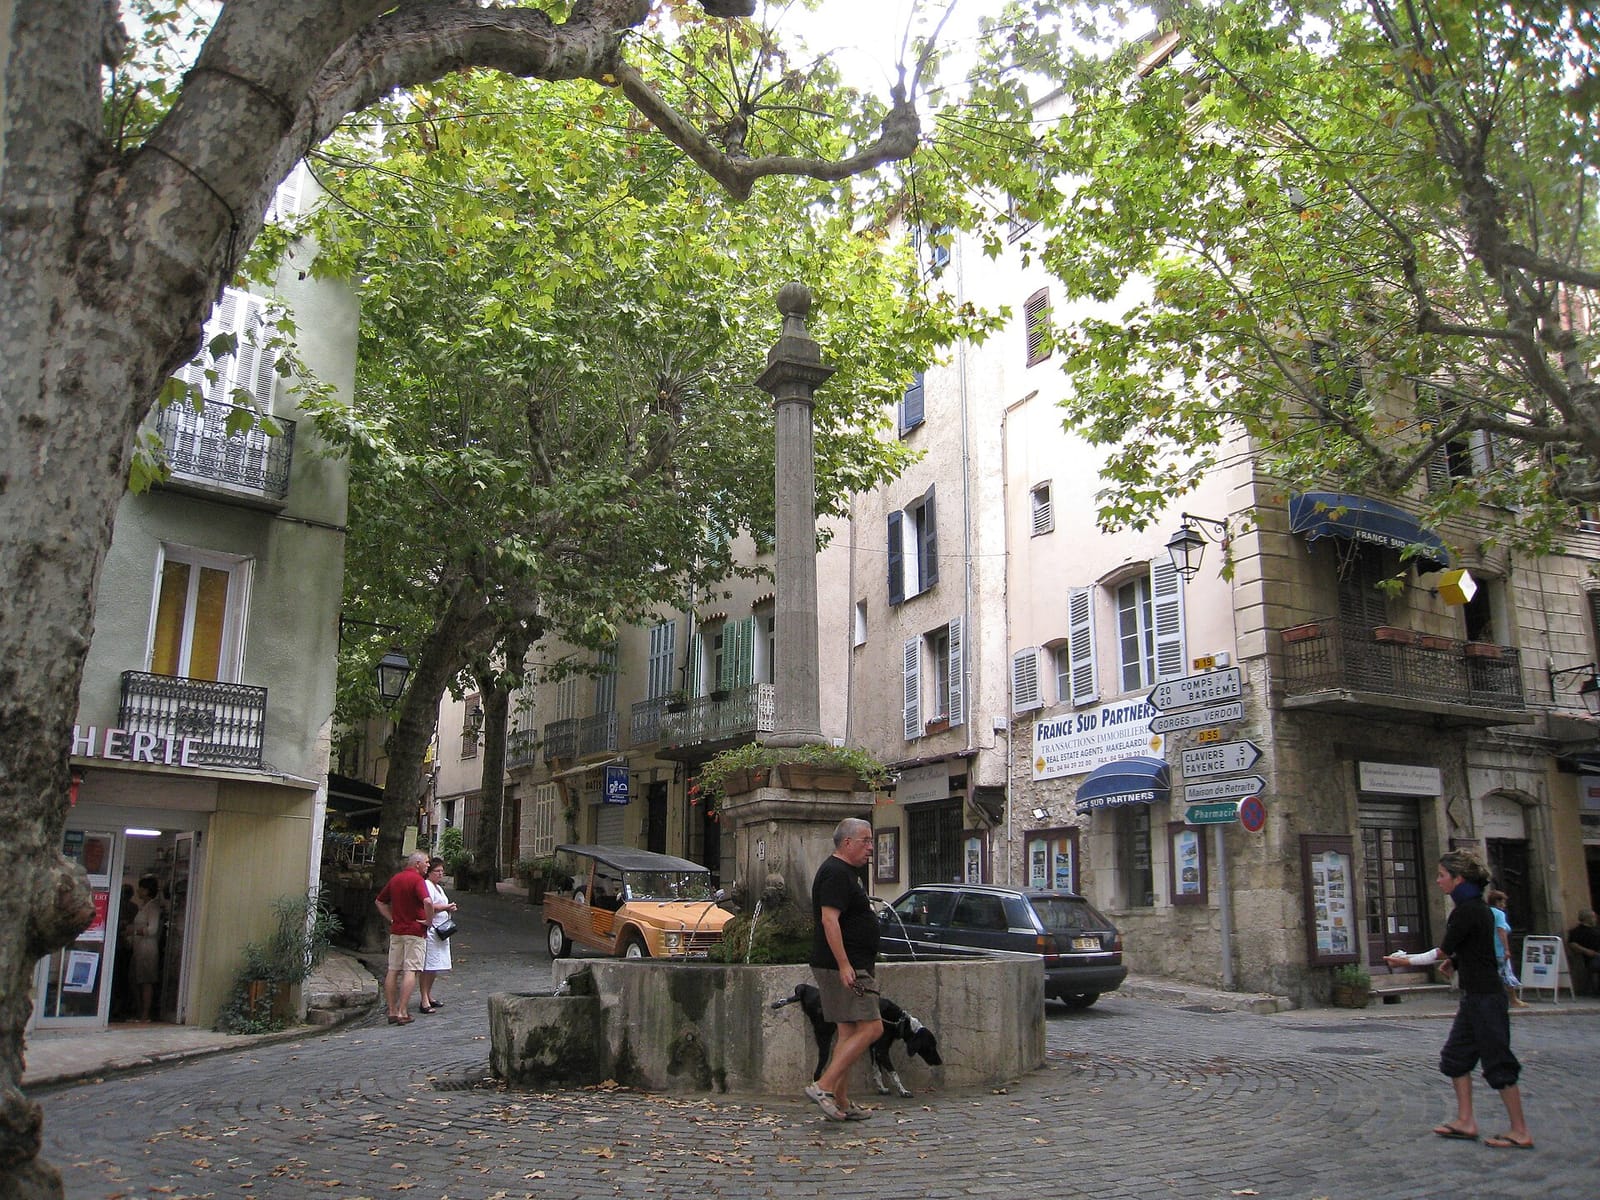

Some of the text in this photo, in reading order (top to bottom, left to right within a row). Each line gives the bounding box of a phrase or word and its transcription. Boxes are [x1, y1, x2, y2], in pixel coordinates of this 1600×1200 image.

[1356, 530, 1405, 548] FRANCE SUD
[1194, 658, 1212, 668] D 19
[1160, 686, 1171, 695] 20
[1181, 677, 1213, 691] COMPS
[1160, 697, 1172, 706] 20
[1037, 703, 1157, 741] FRANCE SUD PARTNERS
[1158, 716, 1190, 729] GORGES
[1204, 706, 1239, 720] VERDON
[1041, 725, 1150, 754] TRANSACTIONS IMMOBILIERE
[1200, 730, 1218, 740] D 55
[1046, 755, 1059, 764] REAL
[1061, 750, 1079, 761] ESTATE
[1081, 746, 1104, 758] AGENTS
[1185, 746, 1245, 762] CLAVIERS 5
[1185, 757, 1245, 773] FAYENCE 17
[1188, 782, 1255, 797] Maison de Retraite
[1090, 798, 1104, 807] SUD
[1106, 791, 1155, 805] PARTNERS
